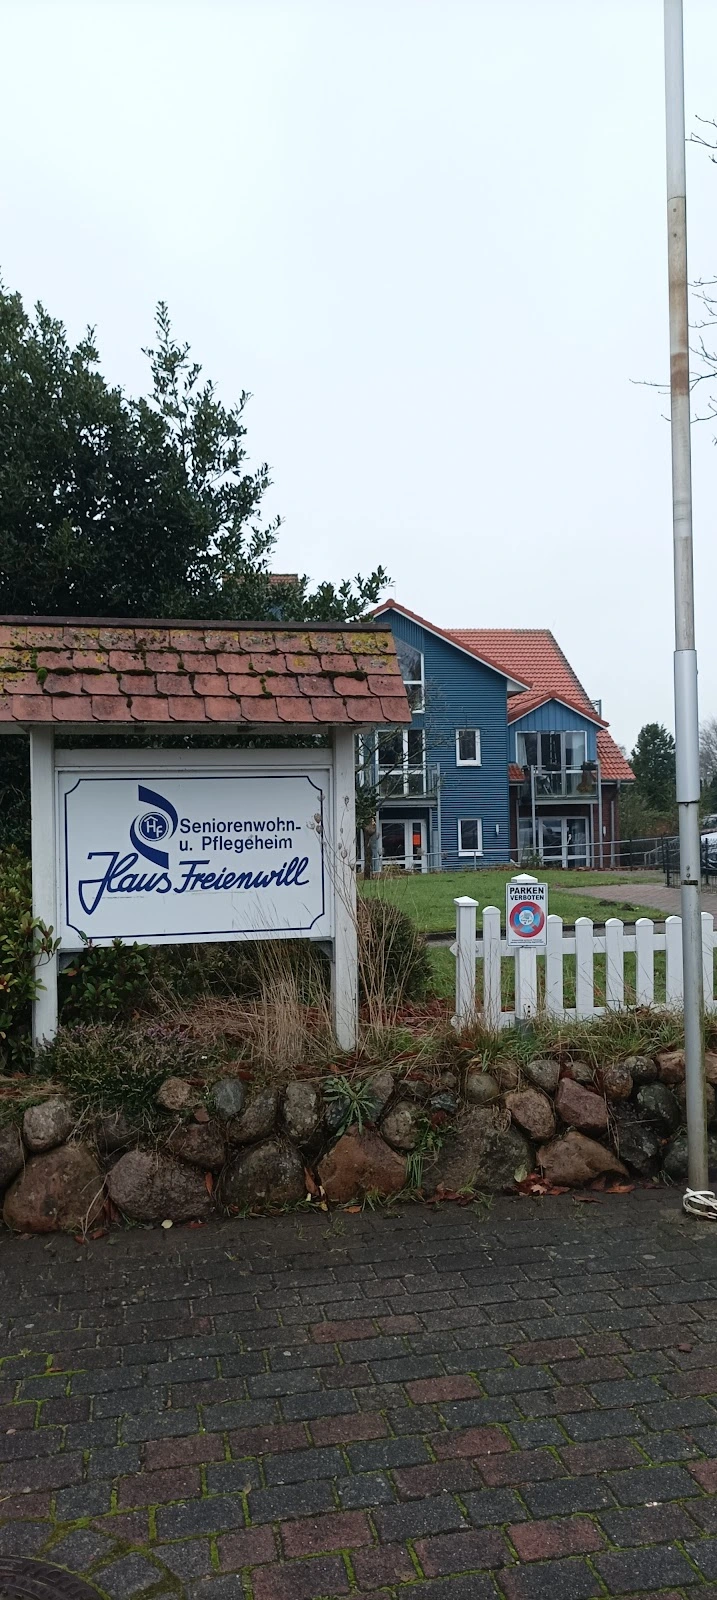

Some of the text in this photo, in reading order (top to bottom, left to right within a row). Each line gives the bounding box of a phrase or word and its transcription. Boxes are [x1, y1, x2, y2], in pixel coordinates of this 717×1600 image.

[179, 817, 302, 834] Seniorenwohn-
[179, 835, 293, 854] u. Pflegeheim
[78, 851, 310, 916] Haus Freienwill
